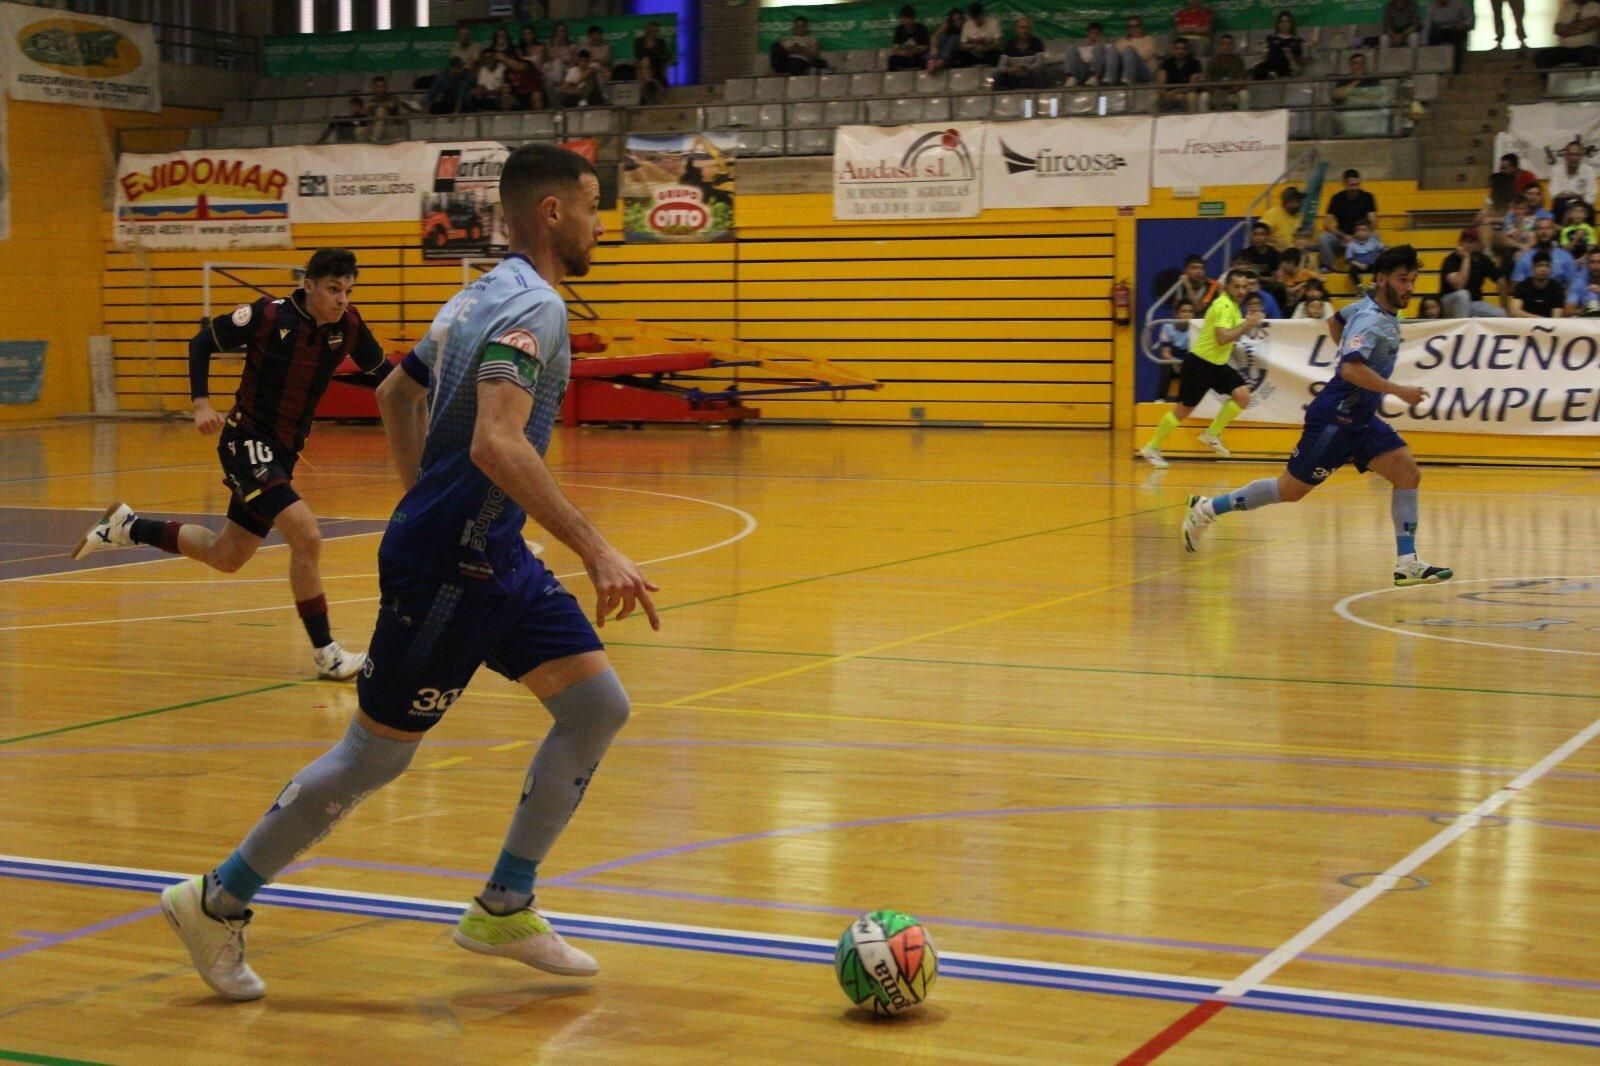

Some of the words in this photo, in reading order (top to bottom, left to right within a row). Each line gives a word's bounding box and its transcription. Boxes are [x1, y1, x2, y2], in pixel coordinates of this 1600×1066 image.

[838, 160, 917, 179] Audasa
[1036, 149, 1117, 172] fircosa
[121, 157, 288, 201] EJIDOMAR
[333, 184, 357, 196] LOS
[658, 189, 699, 200] GRUPO
[655, 209, 703, 227] OTTO
[1415, 325, 1600, 371] SUEÑO
[1377, 386, 1600, 422] CUMPLE
[243, 439, 274, 465] 16
